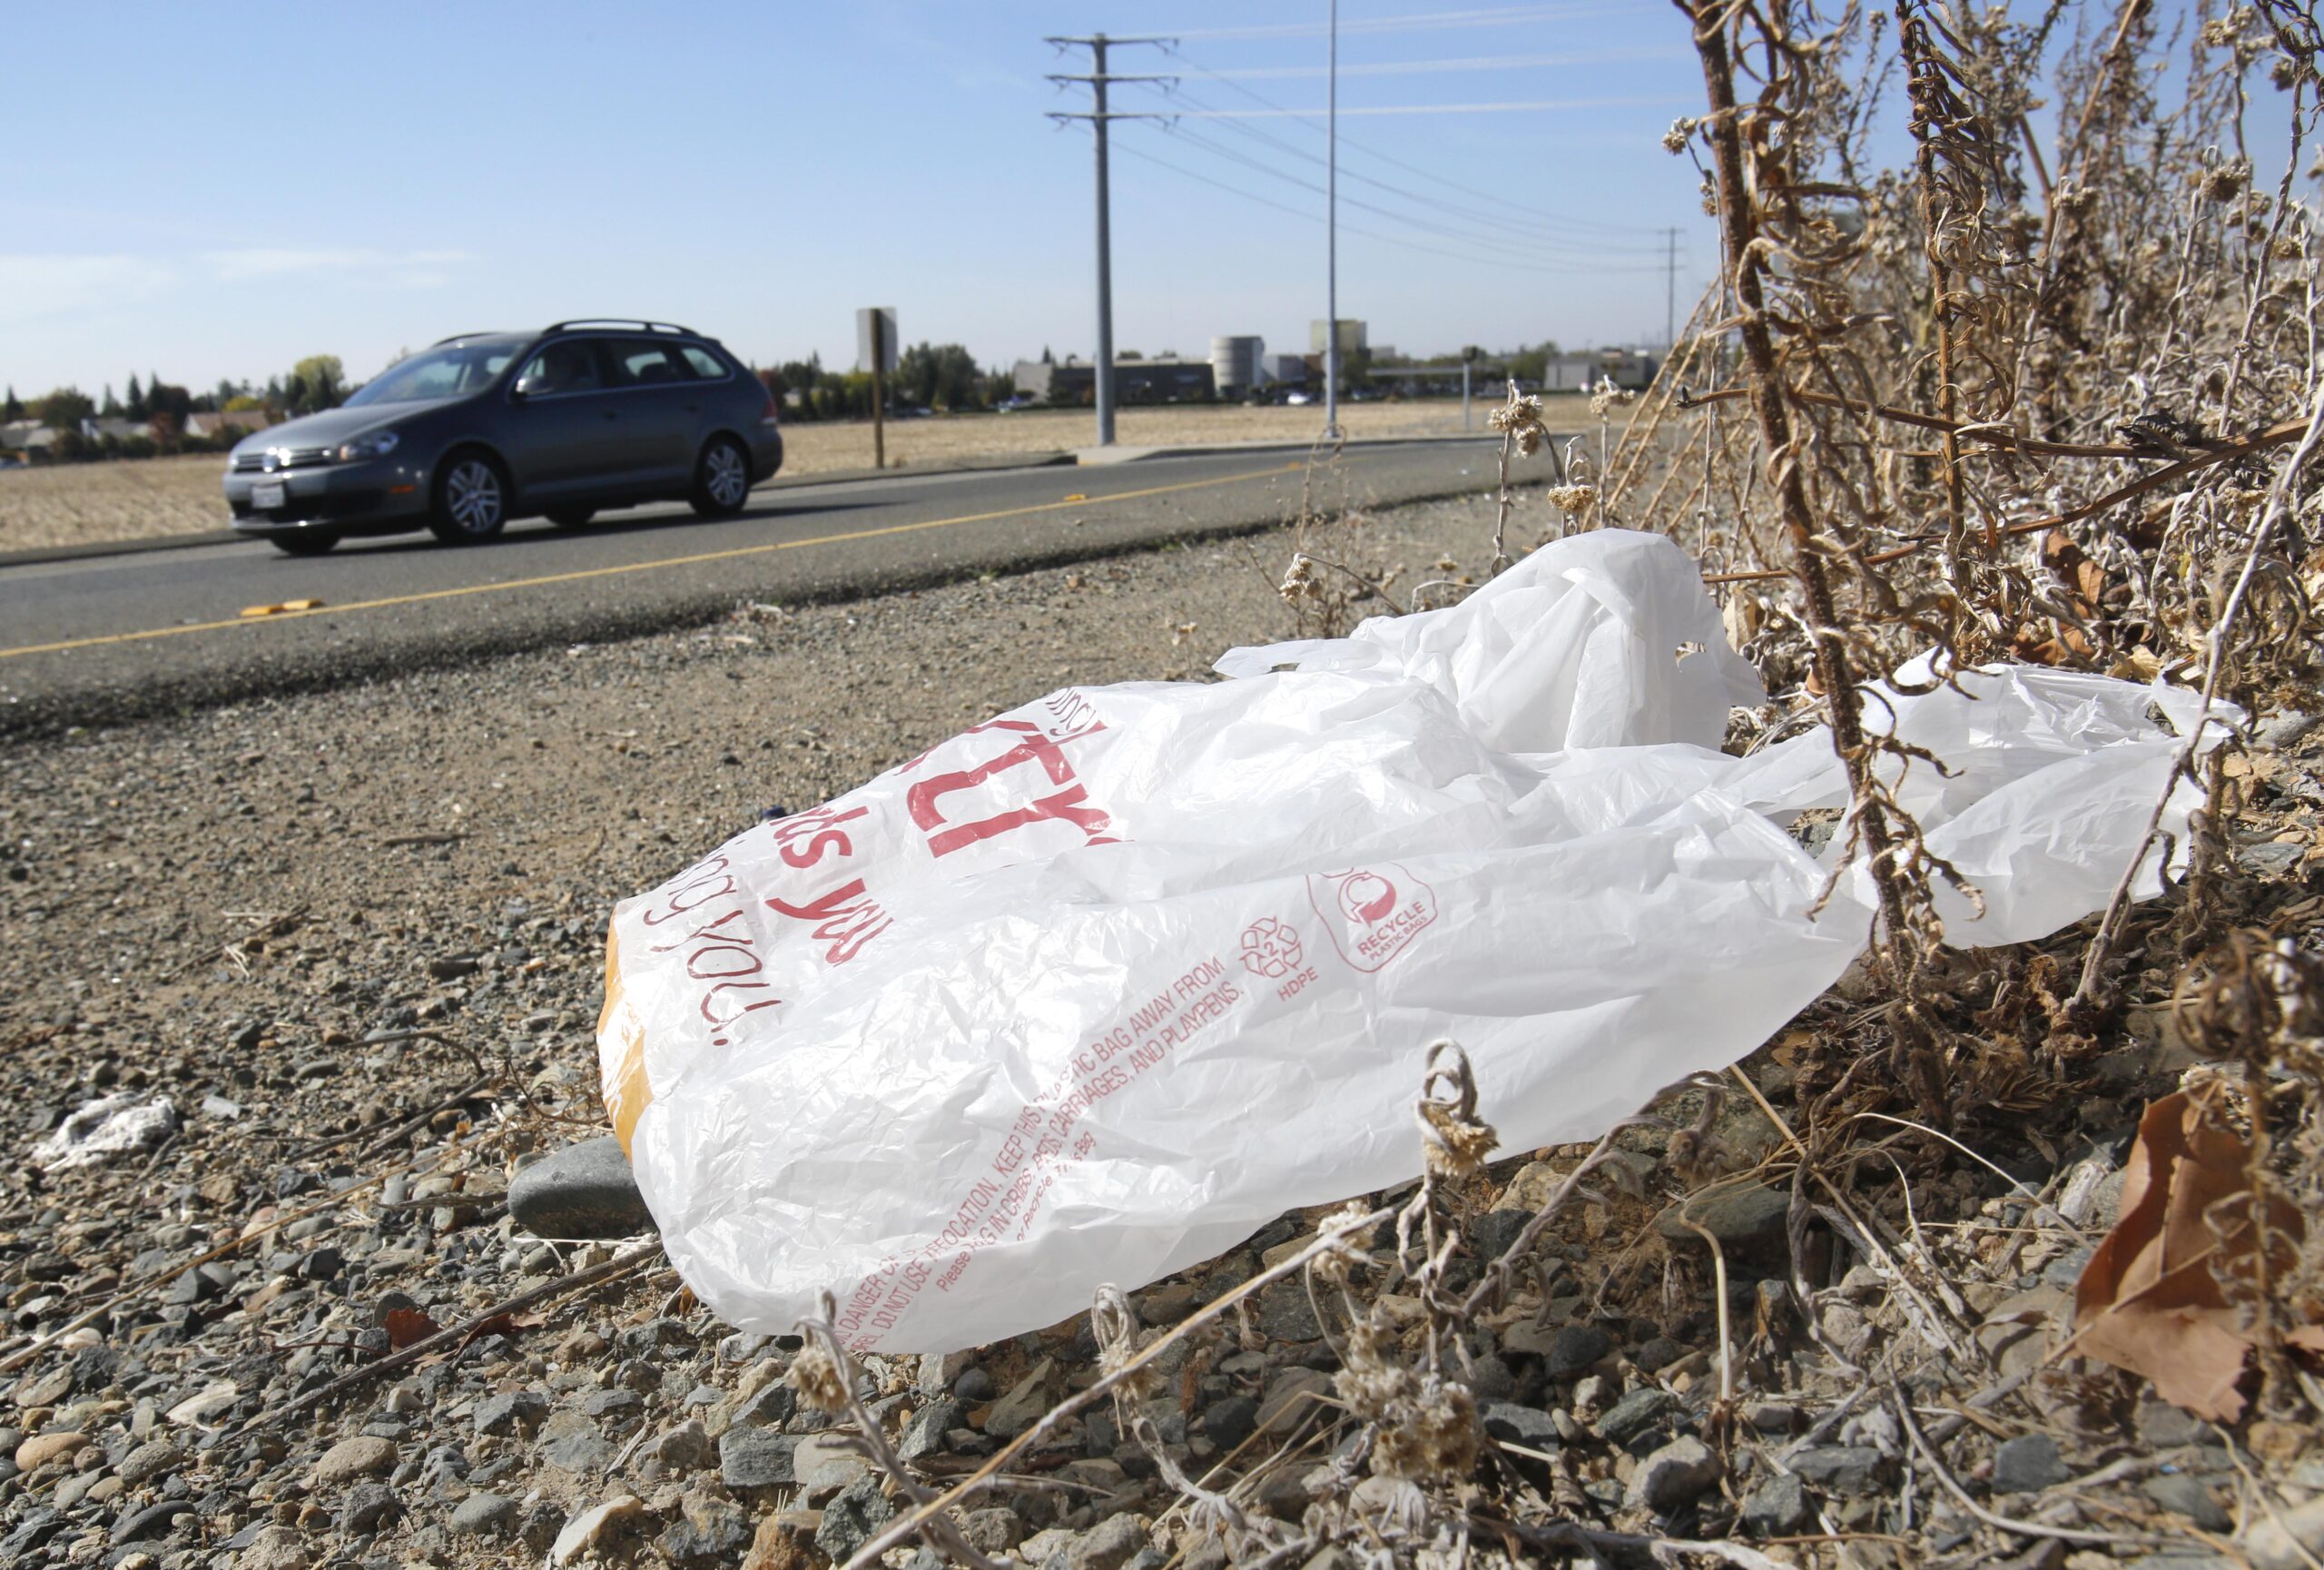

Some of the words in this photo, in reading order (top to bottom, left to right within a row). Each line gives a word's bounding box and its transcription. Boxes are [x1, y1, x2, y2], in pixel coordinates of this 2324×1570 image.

[1357, 901, 1426, 955] RECYCLE
[1369, 933, 1404, 962] PLASTIC
[1402, 914, 1428, 937] BAGS
[1263, 941, 1279, 957] 2
[1276, 966, 1319, 1002] HDPE
[1160, 980, 1245, 1050] PLAYPENS.
[1128, 1039, 1166, 1075] AND
[1049, 1065, 1135, 1138] CARRIAGES,
[839, 1274, 888, 1331] DANGER
[992, 1134, 1026, 1179] KEEP
[1013, 1105, 1042, 1140] THIS
[1091, 1027, 1134, 1063] BAG
[1128, 990, 1177, 1039] AWAY
[1173, 956, 1226, 1002] FROM
[988, 1210, 1011, 1235] IN
[899, 1257, 932, 1293] USE
[936, 1250, 971, 1293] Please
[882, 1286, 914, 1315] NOT
[872, 1310, 898, 1330] DO
